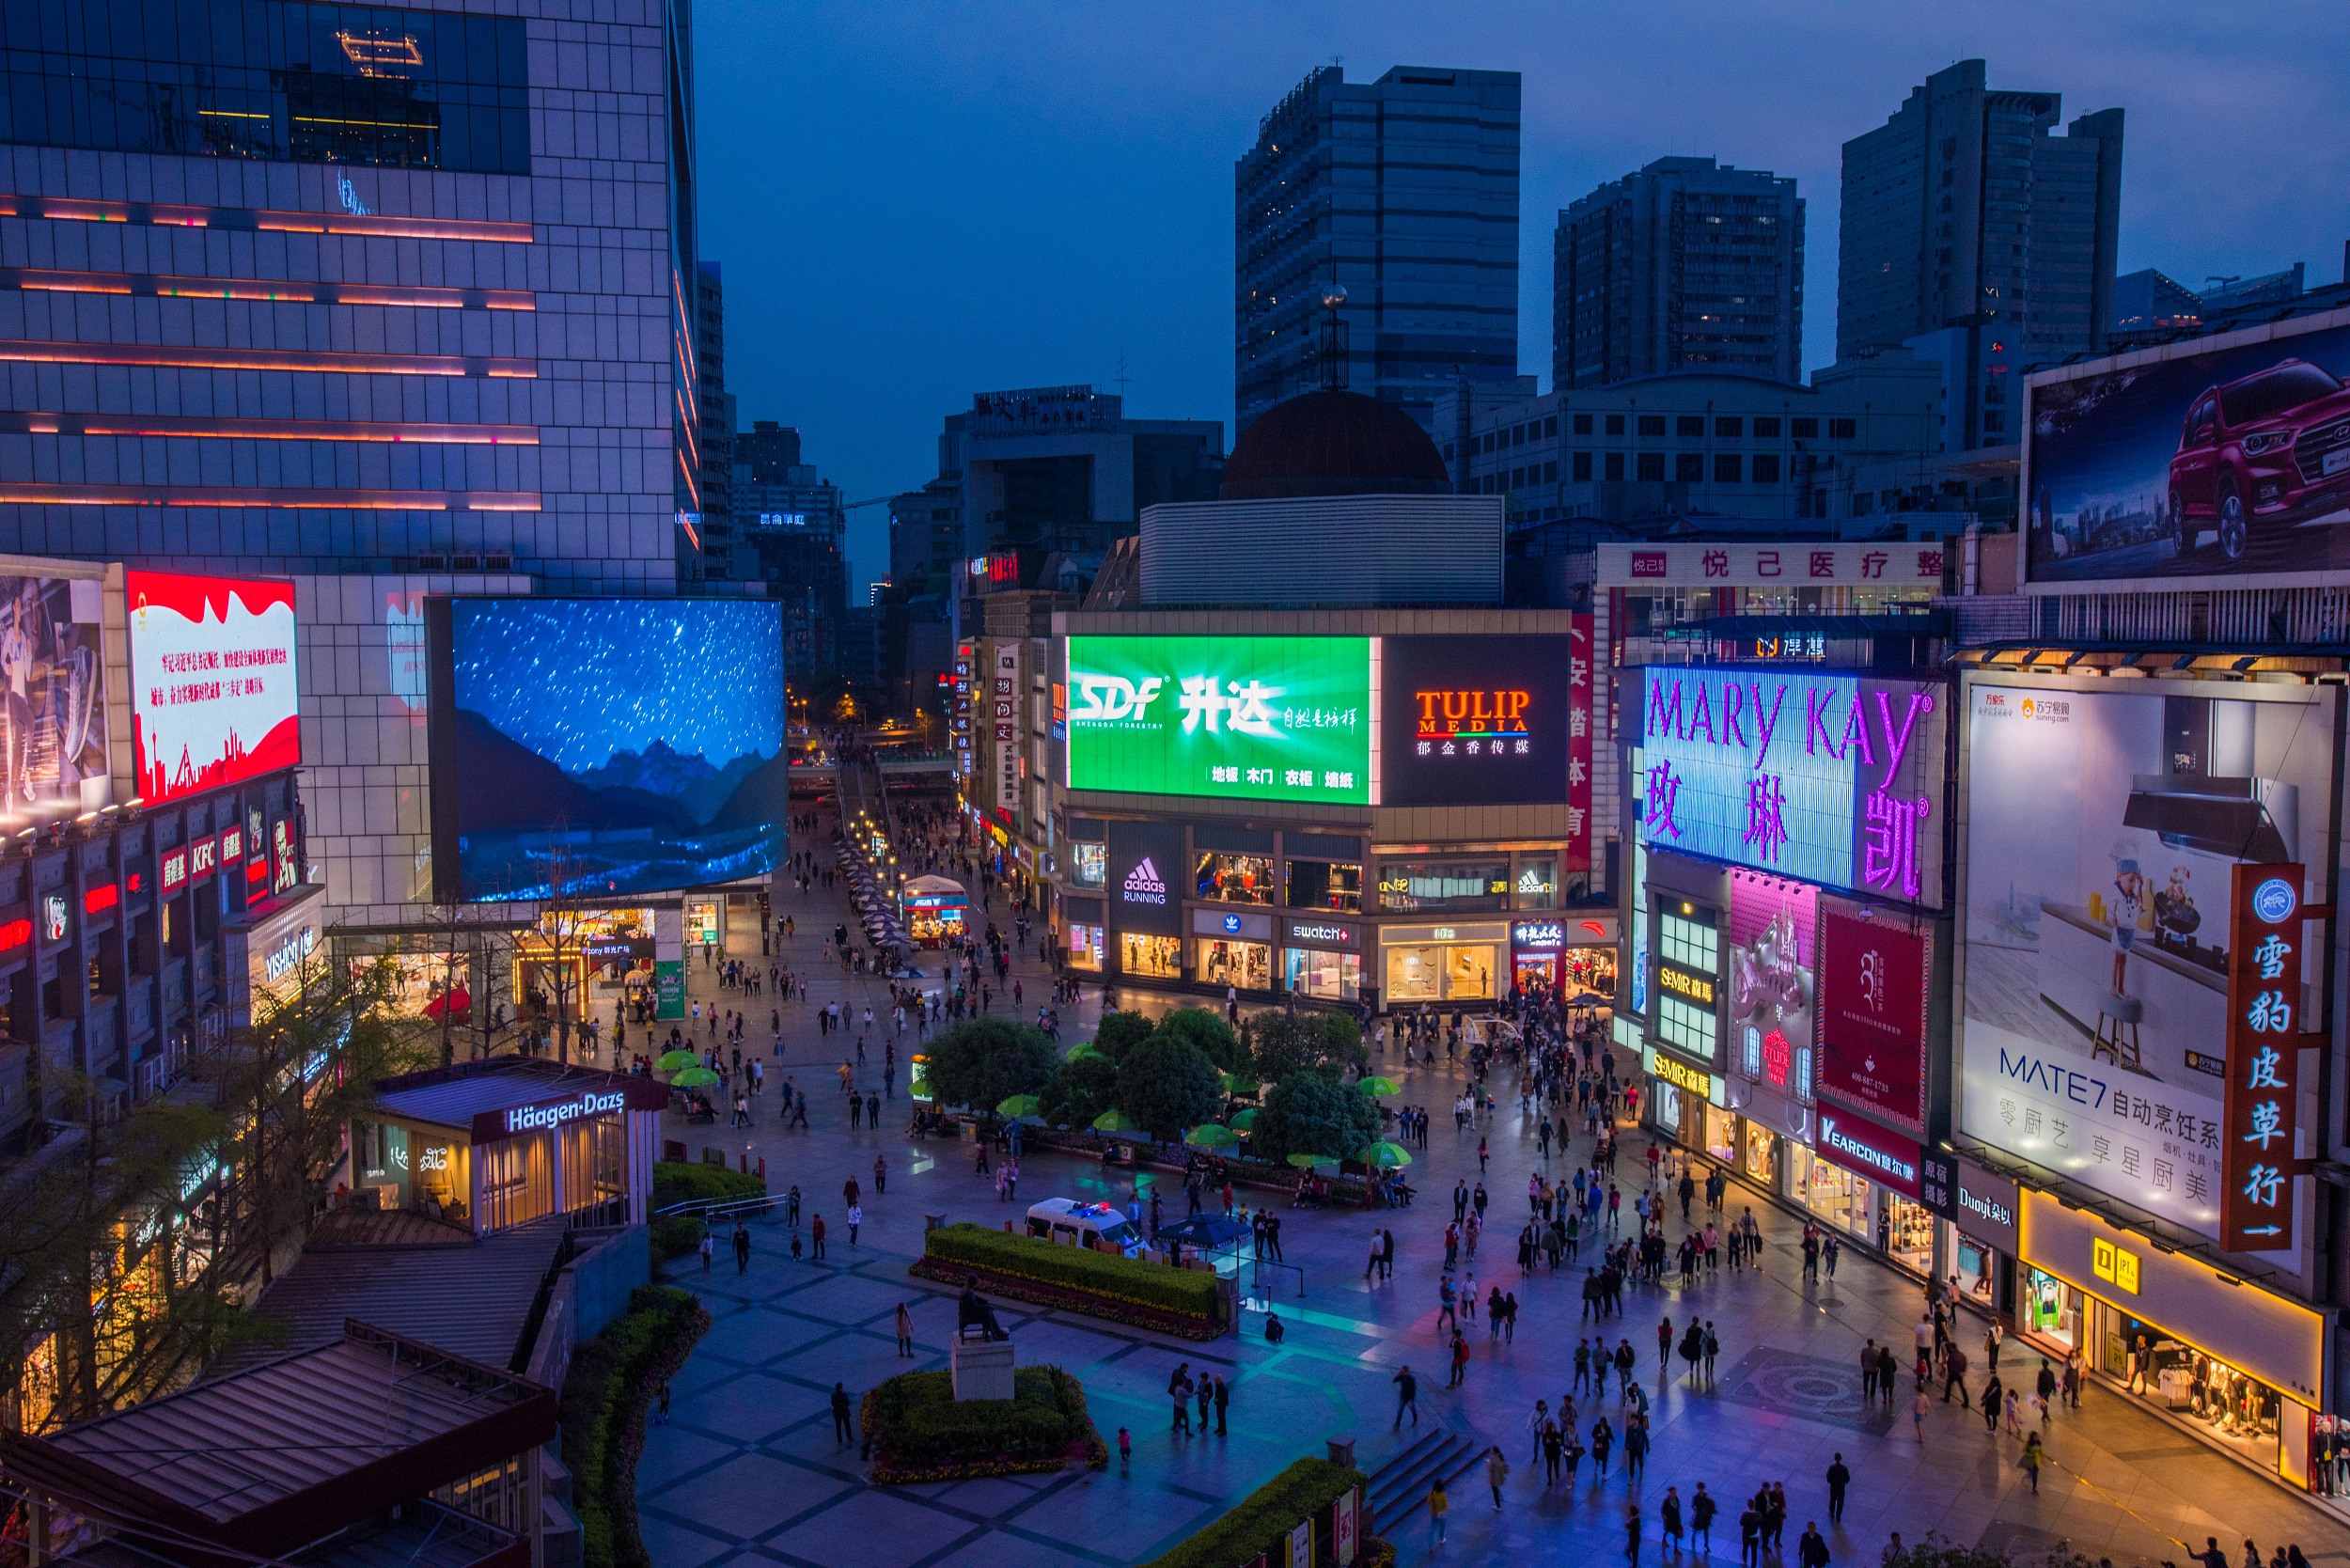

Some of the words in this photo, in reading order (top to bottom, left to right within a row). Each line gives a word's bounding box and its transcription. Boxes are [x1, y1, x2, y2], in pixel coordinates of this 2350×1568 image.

[1075, 676, 1163, 721] SDF
[1179, 674, 1277, 738] 升达
[1416, 691, 1529, 719] TULIP
[2036, 700, 2070, 715] 苏宁易购
[1075, 720, 1114, 729] SHENGDA
[1418, 719, 1528, 733] MEDIA
[2036, 714, 2069, 724] suning.com
[1417, 739, 1528, 756] 郁金香传媒
[1647, 678, 1787, 771] MARY
[1806, 686, 1924, 790] KAY
[1212, 766, 1239, 783] 地板
[1246, 767, 1274, 785] 木门
[1285, 769, 1313, 787] 衣柜
[1324, 771, 1354, 789] 墙纸
[1645, 759, 1920, 897] 玫琳凯
[192, 840, 215, 874] KFC
[223, 831, 242, 862] 肯德基
[164, 853, 186, 888] 肯德基
[1123, 890, 1166, 905] RUNNING
[1124, 878, 1166, 894] adidas
[1292, 925, 1340, 940] swatch
[1763, 1044, 1791, 1069] ETUDE
[1767, 1061, 1787, 1076] HOUSE
[2243, 934, 2293, 1208] 雪豹皮草行
[2000, 1046, 2107, 1109] MATE7
[2113, 1090, 2219, 1151] 自动烹饪系
[1821, 1116, 1881, 1168] YEARCON
[1881, 1155, 1914, 1183] 意尔康
[1999, 1097, 2069, 1150] 零厨艺
[2092, 1134, 2209, 1207] 享星厨美
[1925, 1159, 1948, 1185] 原宿
[1959, 1187, 1991, 1220] Duoyi
[1991, 1202, 2012, 1228] 朵以
